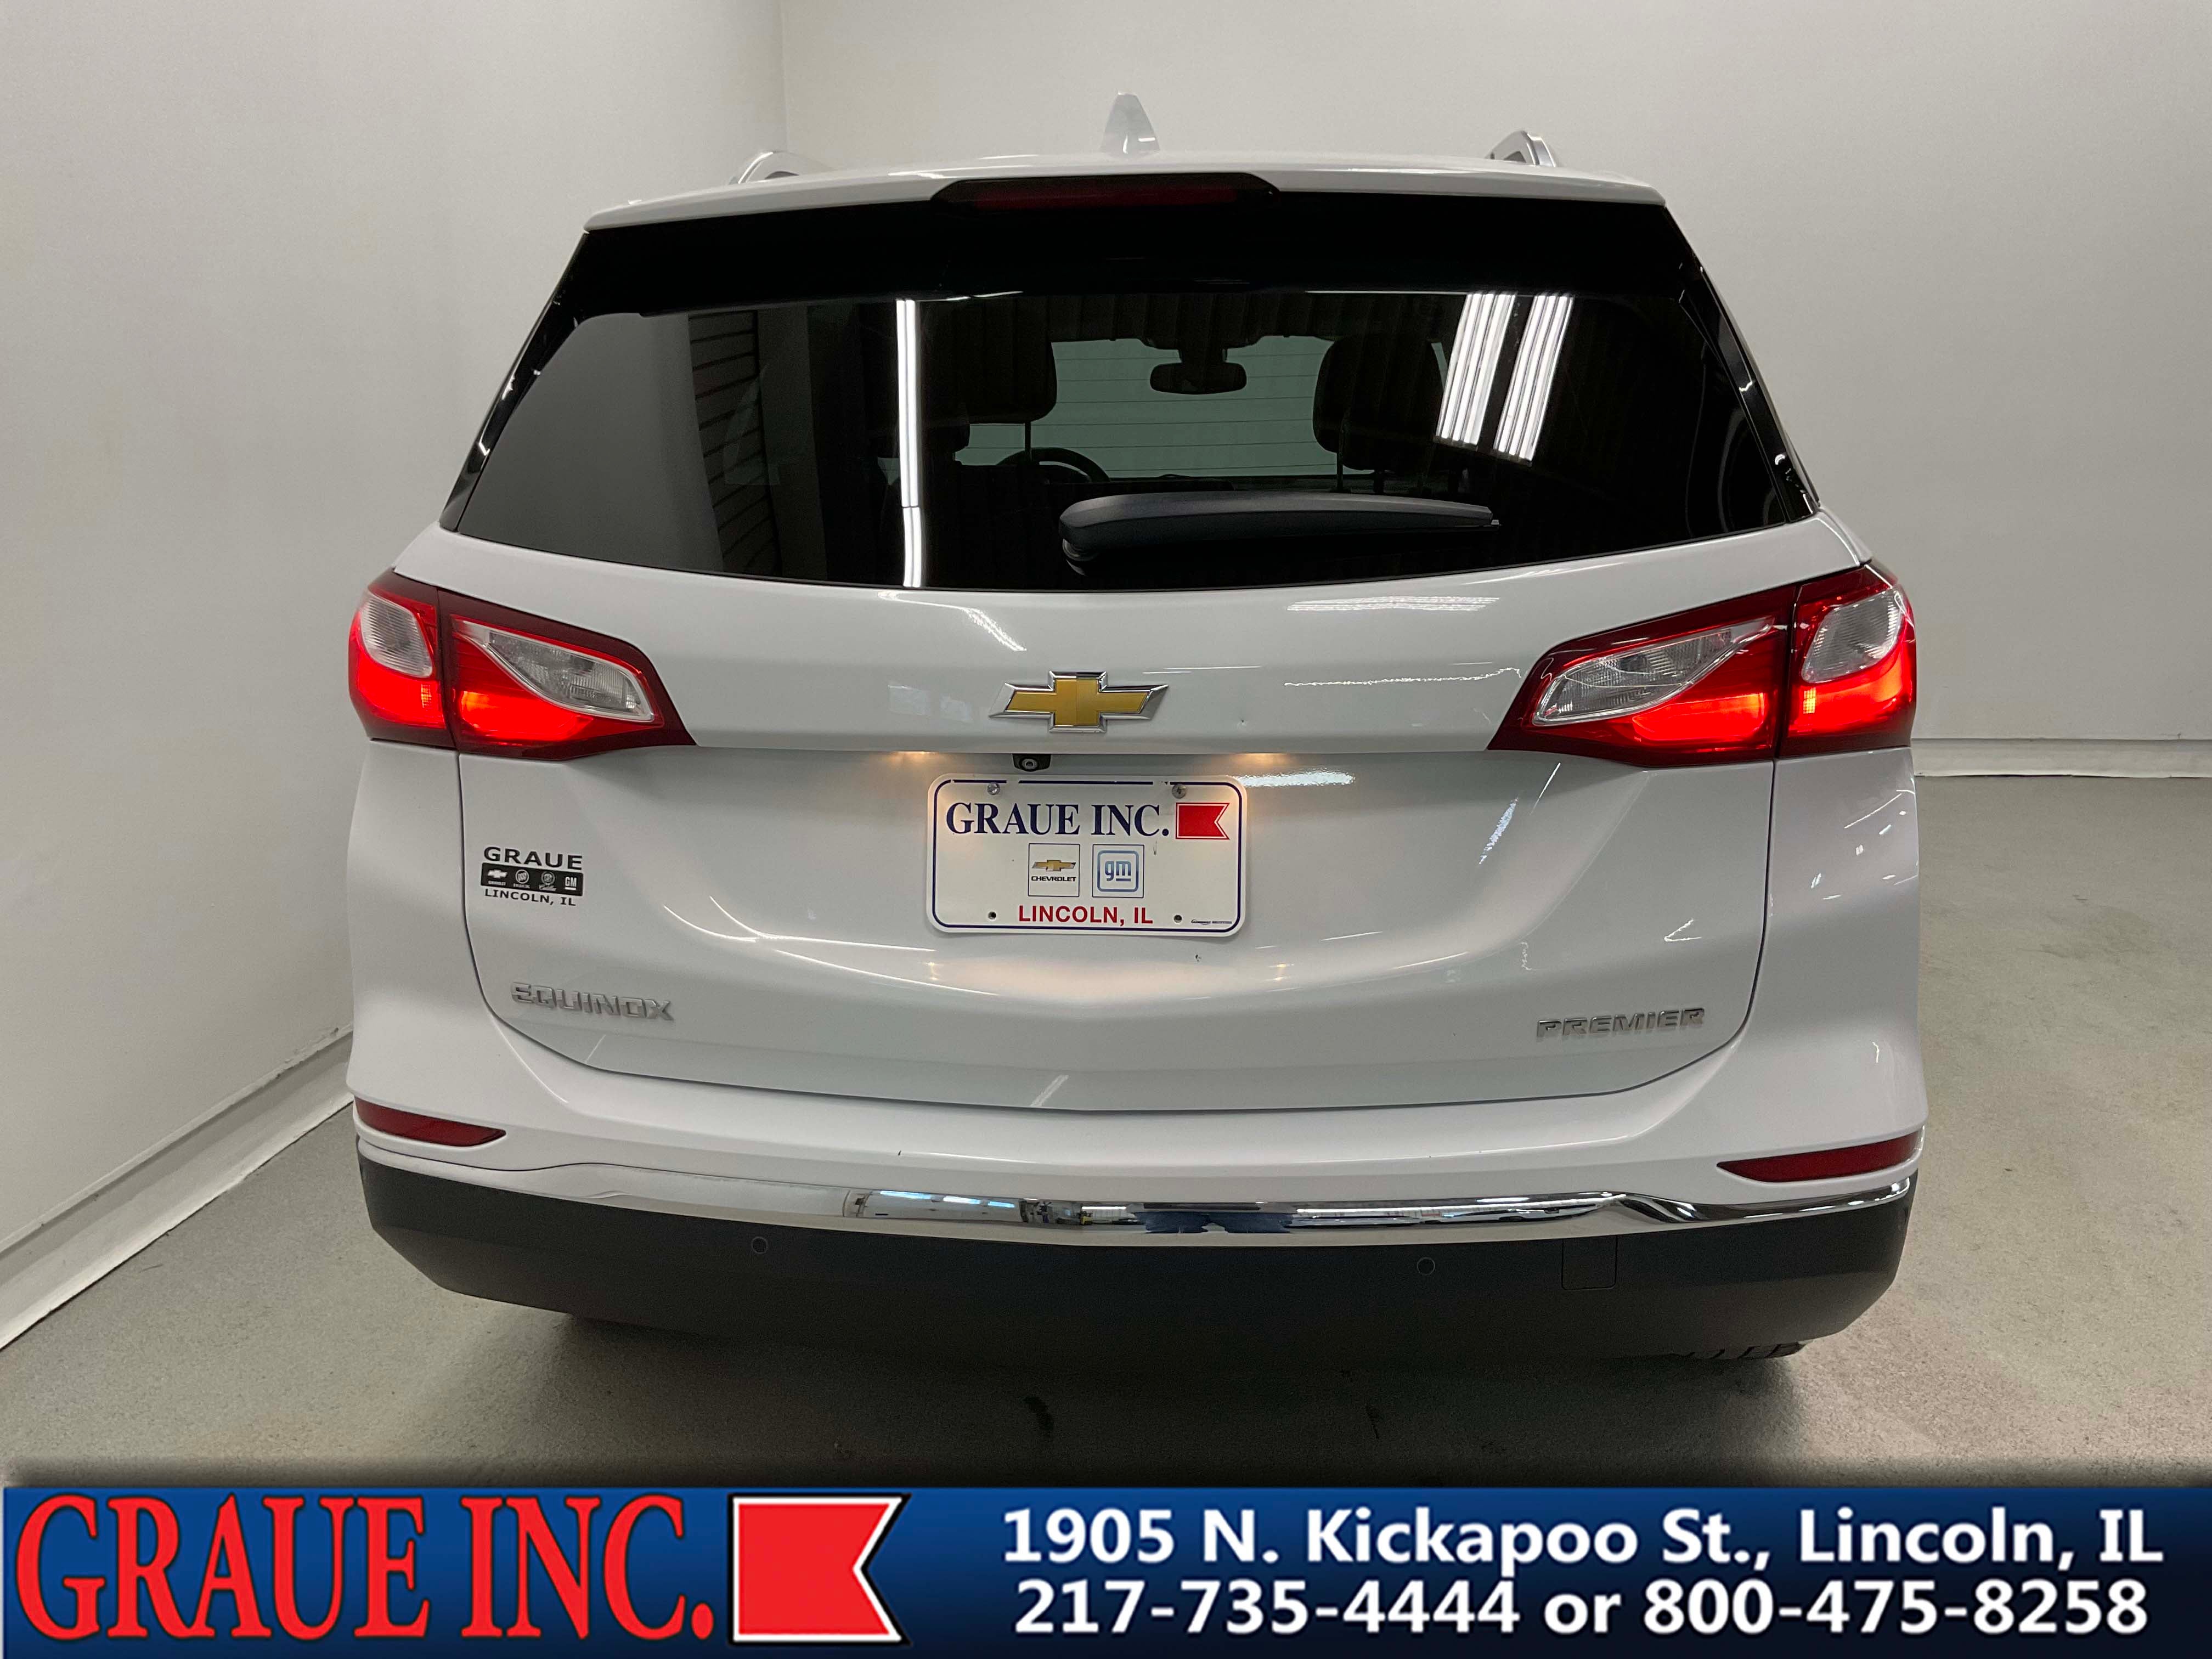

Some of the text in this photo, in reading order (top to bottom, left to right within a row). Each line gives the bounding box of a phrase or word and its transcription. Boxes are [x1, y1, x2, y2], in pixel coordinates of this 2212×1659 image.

[945, 802, 1170, 837] GRAUE INC.
[483, 846, 583, 871] GRAUE
[565, 876, 577, 887] GM
[1104, 860, 1132, 882] gm
[484, 888, 554, 906] LINCOLN,
[560, 896, 577, 906] IL
[1018, 905, 1154, 927] LINCOLN, IL
[511, 981, 675, 1022] EQUINOX
[1536, 1007, 1706, 1038] PREMIER
